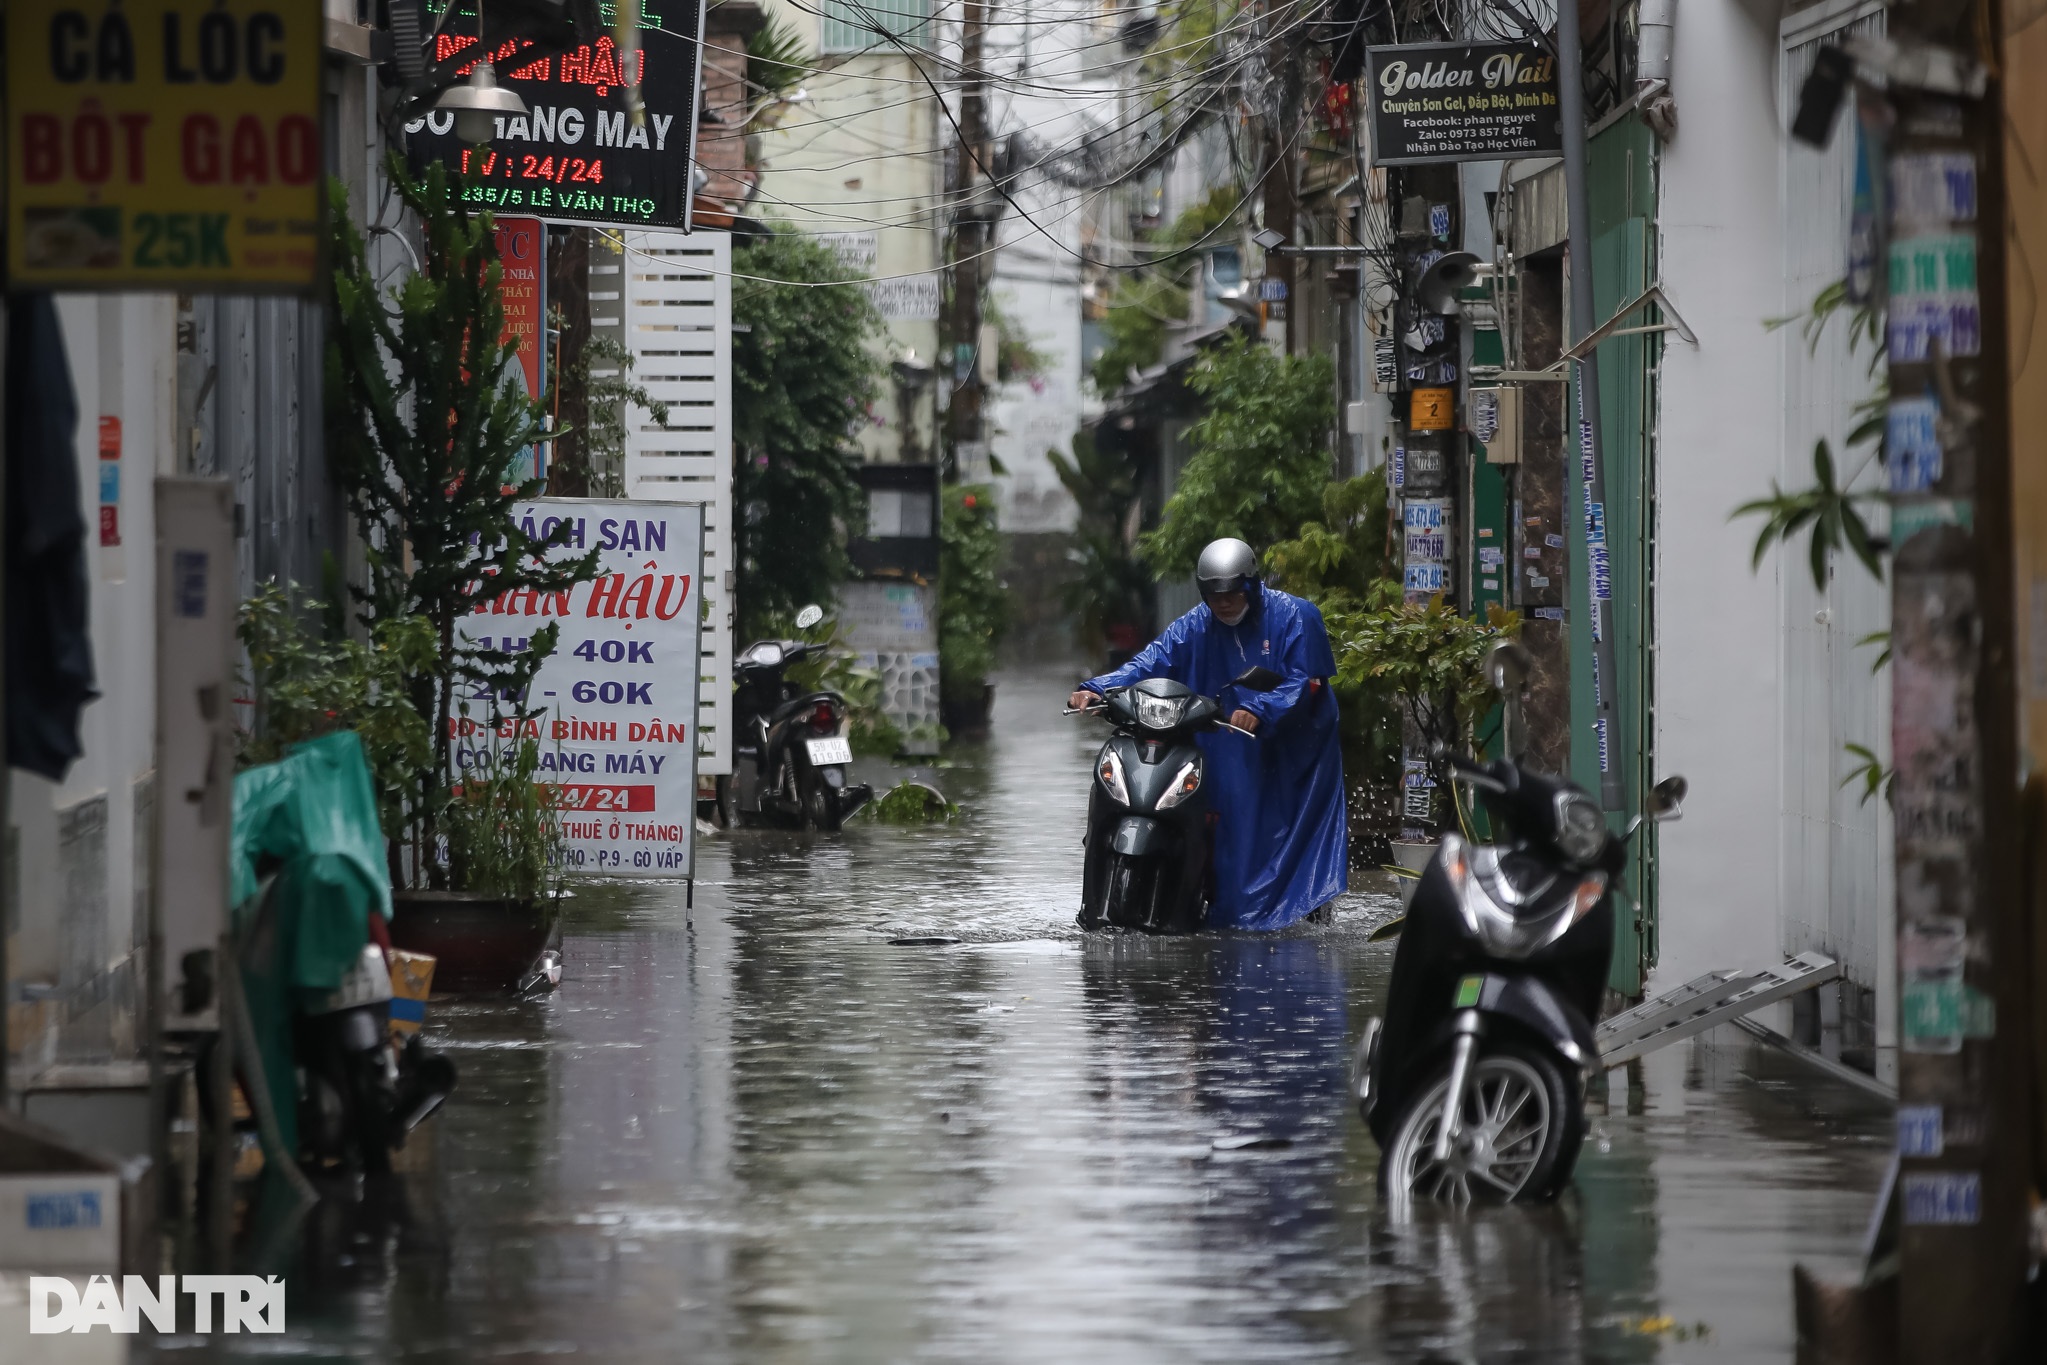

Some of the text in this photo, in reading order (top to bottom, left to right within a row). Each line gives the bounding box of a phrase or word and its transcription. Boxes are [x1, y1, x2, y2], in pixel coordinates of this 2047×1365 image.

[1380, 52, 1553, 97] Golden Nail
[1382, 98, 1421, 115] Chuyên
[1423, 97, 1441, 111] Sơn
[1444, 96, 1466, 112] Gel,
[1468, 91, 1489, 111] Đắp
[1491, 94, 1513, 111] Bột,
[1516, 92, 1539, 107] Đính
[1404, 113, 1536, 128] Facebook: phan nguyet
[1419, 126, 1523, 140] Zalo: 0973 857 647
[22, 97, 319, 203] BỘT GẠO
[1407, 138, 1536, 155] Nhận Đào Tạo Học Viên
[522, 155, 604, 184] 24/24
[530, 186, 551, 207] LÊ
[558, 190, 604, 212] VĂN
[612, 196, 655, 219] THỌ
[131, 212, 231, 269] 25K
[510, 266, 535, 280] NHÀ
[600, 518, 667, 557] SẠN
[586, 560, 691, 631] HẬU
[573, 638, 655, 664] 40K
[572, 681, 654, 705] 60K
[552, 715, 617, 742] BÌNH
[628, 717, 685, 743] DÂN
[605, 749, 666, 775] MÁY
[562, 821, 602, 840] THUÊ
[609, 820, 620, 840] Ở
[626, 819, 683, 843] THÁNG)
[600, 849, 619, 867] P.9
[634, 846, 652, 868] GÒ
[656, 845, 684, 870] VẤP
